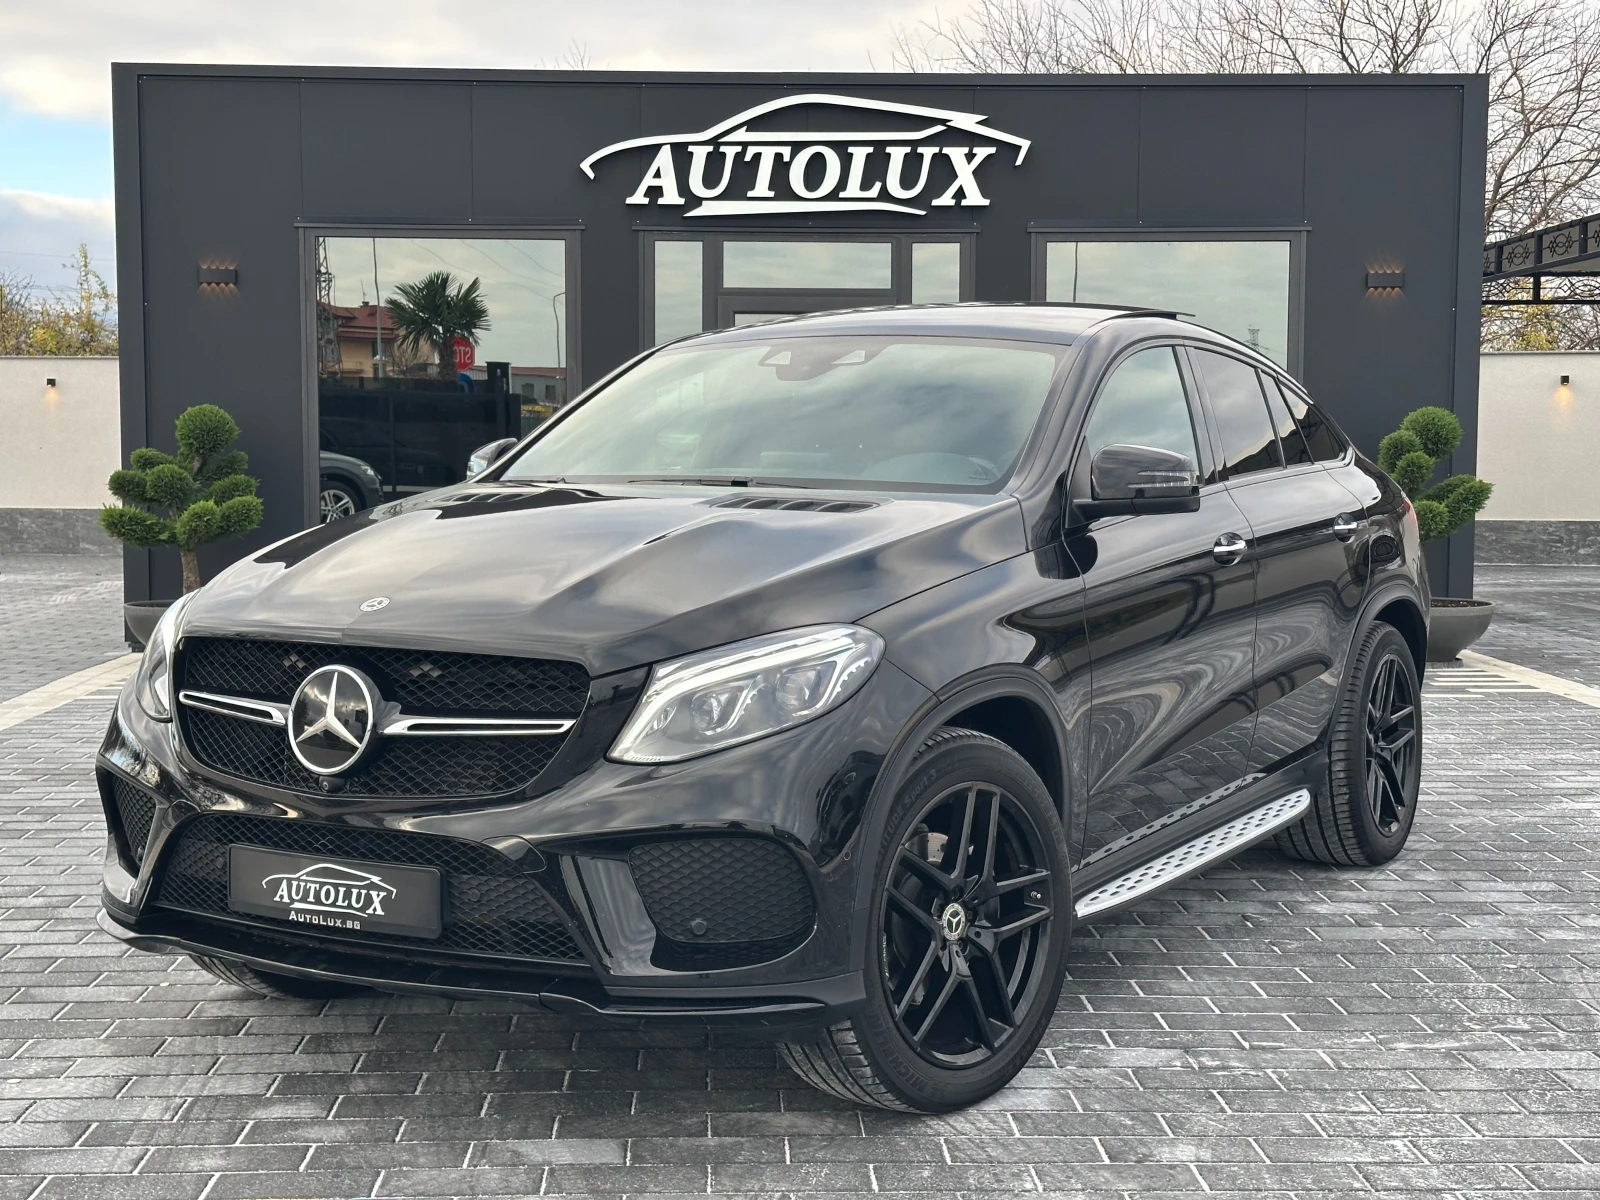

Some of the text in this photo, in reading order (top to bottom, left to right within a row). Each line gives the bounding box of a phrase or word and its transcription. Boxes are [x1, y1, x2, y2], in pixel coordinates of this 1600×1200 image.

[624, 144, 997, 206] AUTOLUX
[903, 775, 929, 808] Sport
[273, 878, 388, 916] AUTOLUX
